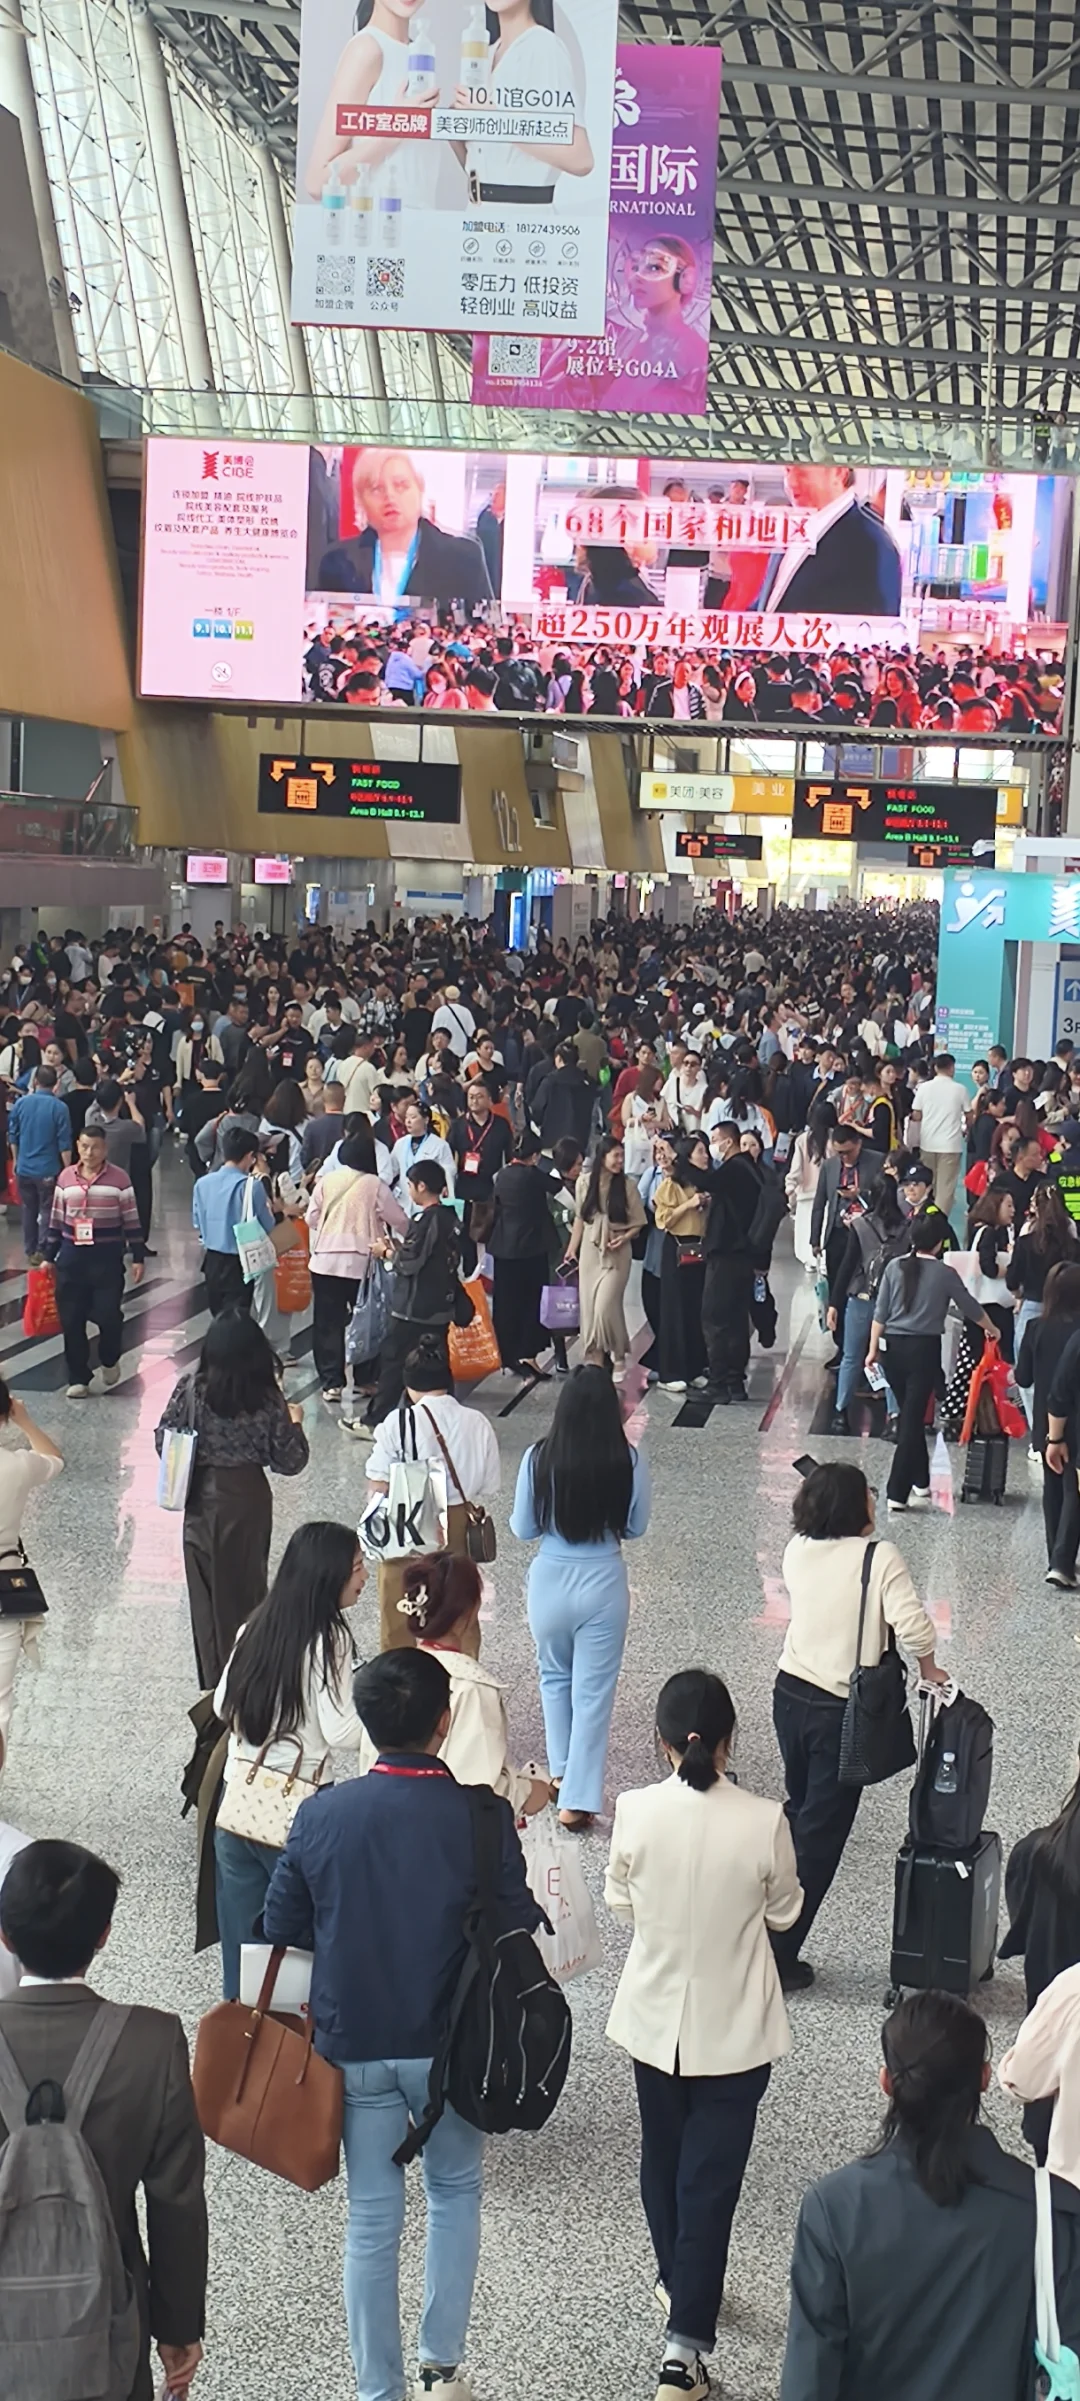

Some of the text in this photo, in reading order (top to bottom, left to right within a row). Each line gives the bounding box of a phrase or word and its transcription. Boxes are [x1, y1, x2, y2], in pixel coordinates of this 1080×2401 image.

[468, 87, 575, 108] 10.1馆G01A
[341, 112, 568, 138] 工作室品牌 美容师创业新起点
[611, 143, 699, 196] 国际
[516, 223, 580, 236] 18127439506
[461, 273, 578, 296] 零压力 低投资
[370, 301, 398, 312] 公众号
[460, 297, 577, 319] 轻创业 高收益
[566, 355, 678, 379] 展位号G04A
[223, 455, 254, 466] 美博会
[222, 467, 254, 478] CIBE
[566, 503, 812, 546] 68个国家和地区
[195, 623, 253, 635] 9.1 10.1 11.1
[536, 610, 832, 649] 超250万年观展人次
[351, 778, 400, 789] FAST FOOD
[886, 803, 935, 814] FAST FOOD
